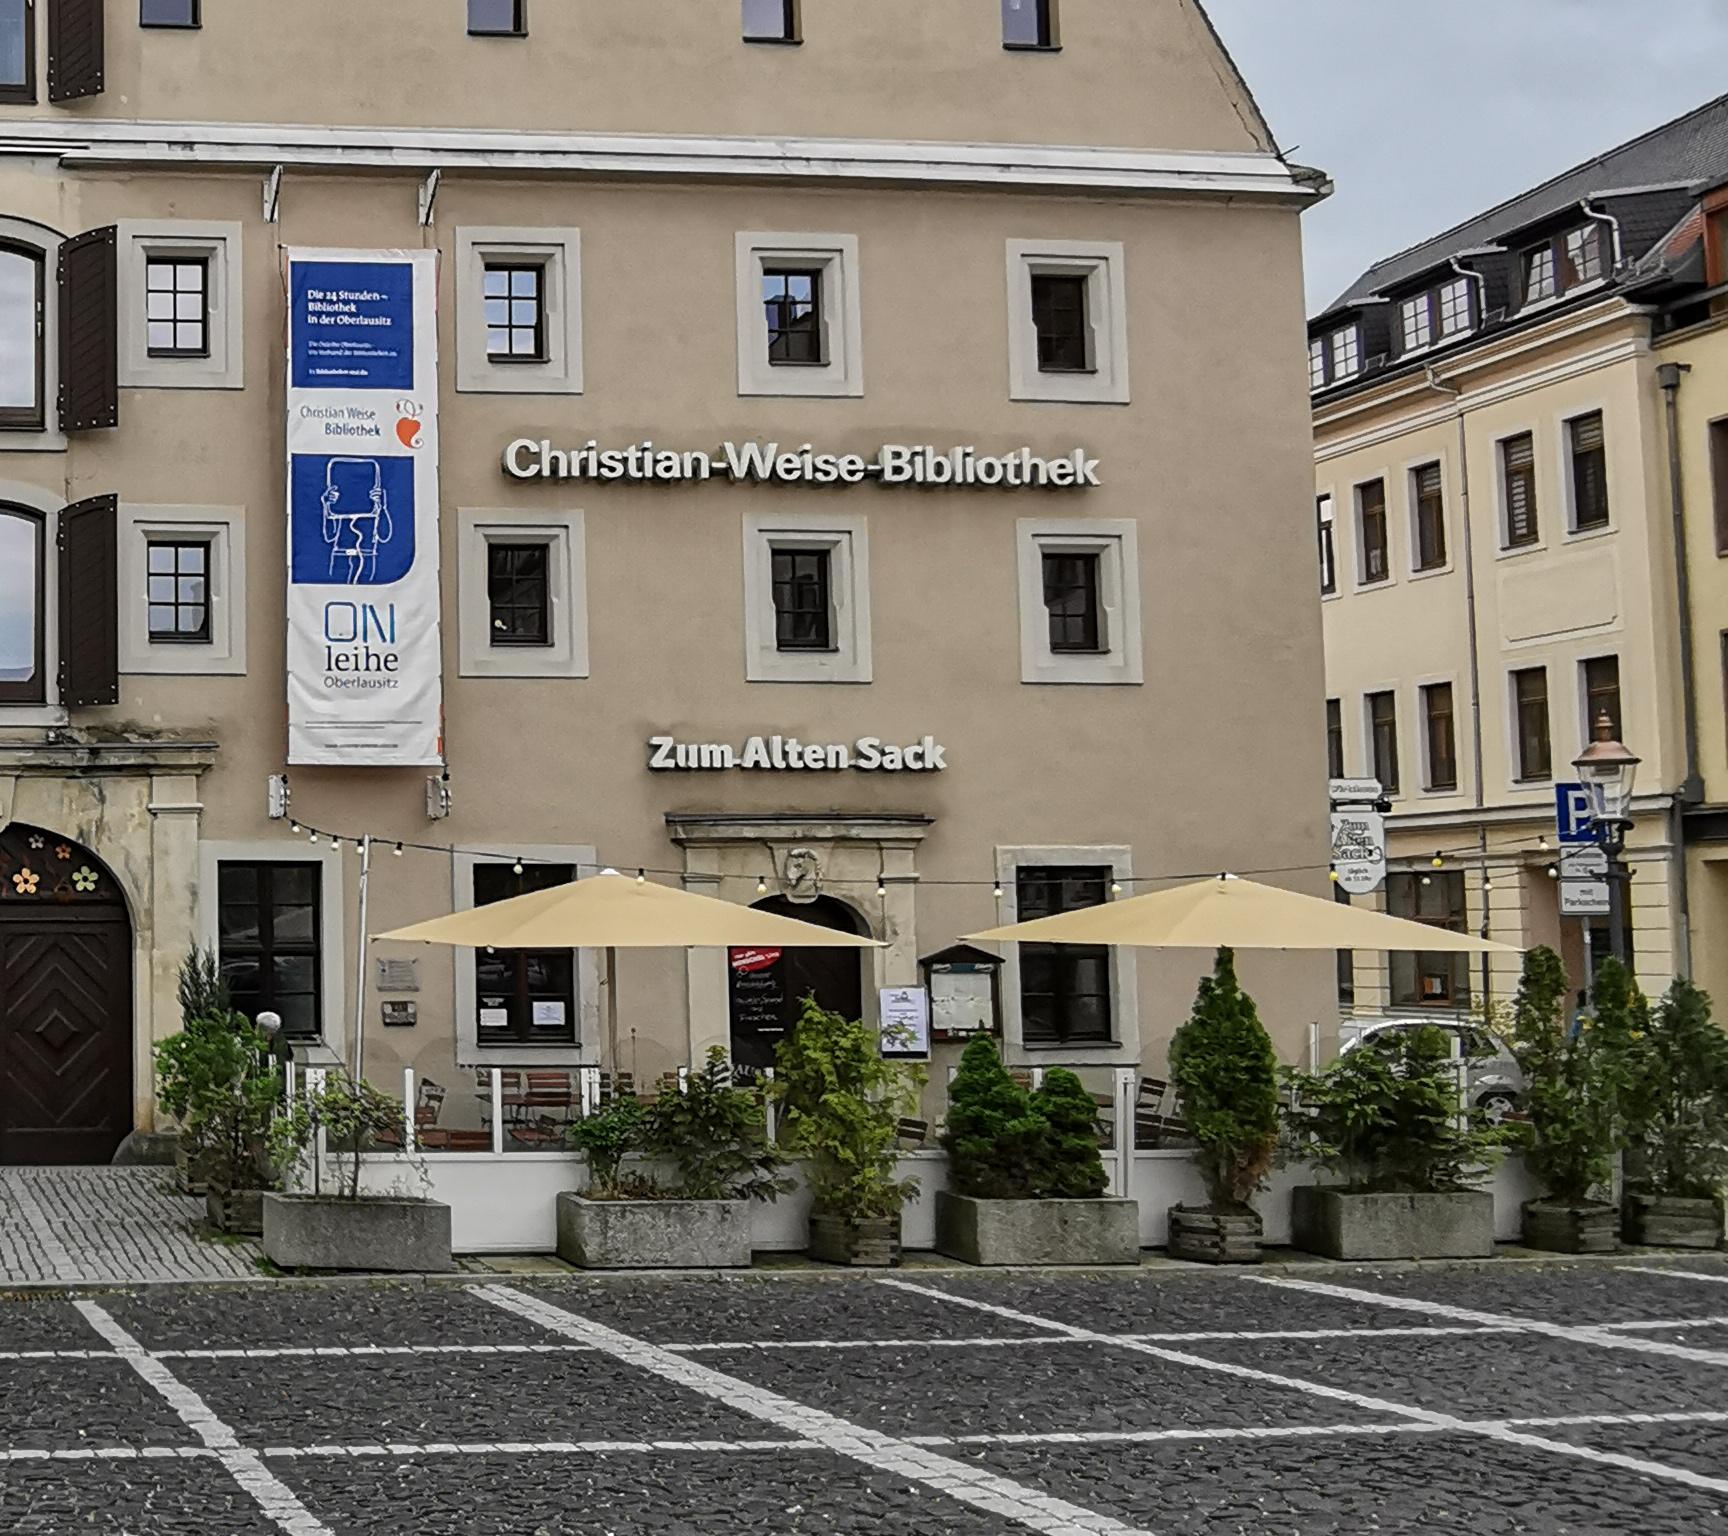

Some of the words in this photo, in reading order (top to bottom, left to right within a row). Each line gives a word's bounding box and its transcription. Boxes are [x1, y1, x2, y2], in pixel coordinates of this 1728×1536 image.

[307, 289, 324, 300] Die
[338, 290, 380, 301] Stunden
[308, 303, 357, 313] Bibliothek
[307, 315, 318, 325] in
[319, 315, 335, 325] der
[336, 315, 392, 326] Oberlausitz
[300, 405, 345, 419] Christian
[346, 407, 376, 420] Weise
[325, 423, 381, 436] Bibliothek
[503, 438, 1101, 486] Christian-Weise-Bibliothek
[325, 645, 399, 672] leihe
[324, 676, 399, 689] Oberlausitz
[649, 735, 734, 769] Zum
[740, 735, 849, 769] Alten
[855, 735, 948, 770] Sack
[1567, 790, 1593, 835] P
